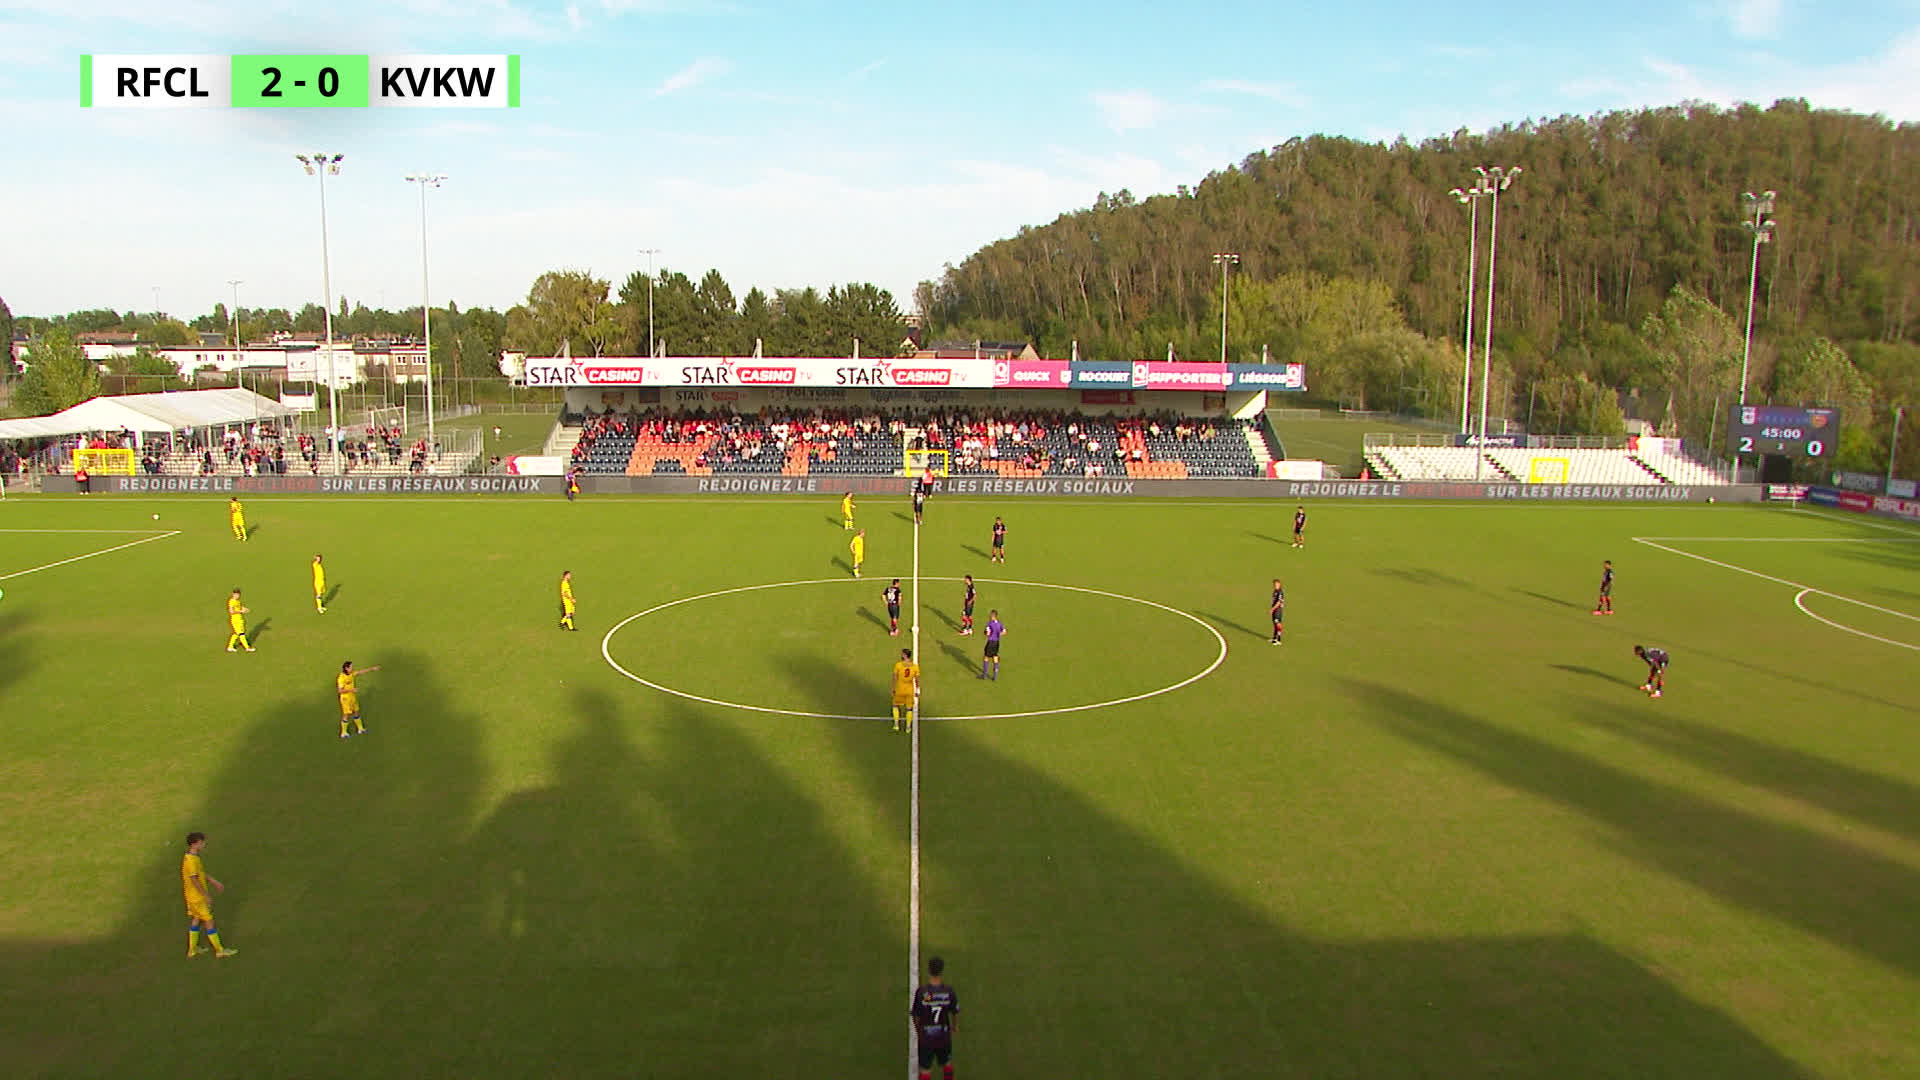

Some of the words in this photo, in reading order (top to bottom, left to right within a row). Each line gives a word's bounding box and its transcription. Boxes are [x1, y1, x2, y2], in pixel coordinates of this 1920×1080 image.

[530, 367, 577, 384] STAR
[588, 370, 641, 382] CASINO
[647, 371, 660, 380] TV
[682, 367, 729, 384] STAR
[741, 370, 791, 382] CASINO
[800, 371, 812, 380] TV
[836, 368, 884, 385] STAR
[896, 371, 948, 383] CASINO
[954, 372, 967, 381] TV
[1013, 371, 1050, 382] QUICK
[1078, 372, 1130, 382] ROCOURT
[1149, 372, 1221, 384] SUPPORTER
[675, 391, 704, 401] STAR
[1761, 428, 1802, 439] 45:00
[1739, 437, 1753, 453] 2
[1807, 440, 1824, 456] 0
[120, 479, 209, 490] REJOIGNEZ
[214, 479, 232, 490] LE
[322, 479, 353, 491] SUR
[358, 479, 387, 491] LES
[392, 477, 465, 491] RÉSEAUX
[470, 479, 540, 491] SOCIAUX
[699, 479, 791, 491] REJOIGNEZ
[797, 479, 816, 491] LE
[948, 480, 977, 492] LES
[983, 478, 1057, 493] RÉSEAUX
[1063, 481, 1134, 493] SOCIAUX
[1289, 483, 1377, 495] REJOIGNEZ
[1382, 484, 1400, 495] LE
[1487, 486, 1517, 498] SUR
[1521, 486, 1548, 498] LES
[1552, 484, 1621, 499] RÉSEAUX
[1625, 487, 1690, 499] SOCIAUX
[905, 668, 911, 678] 9
[931, 1006, 942, 1024] 7
